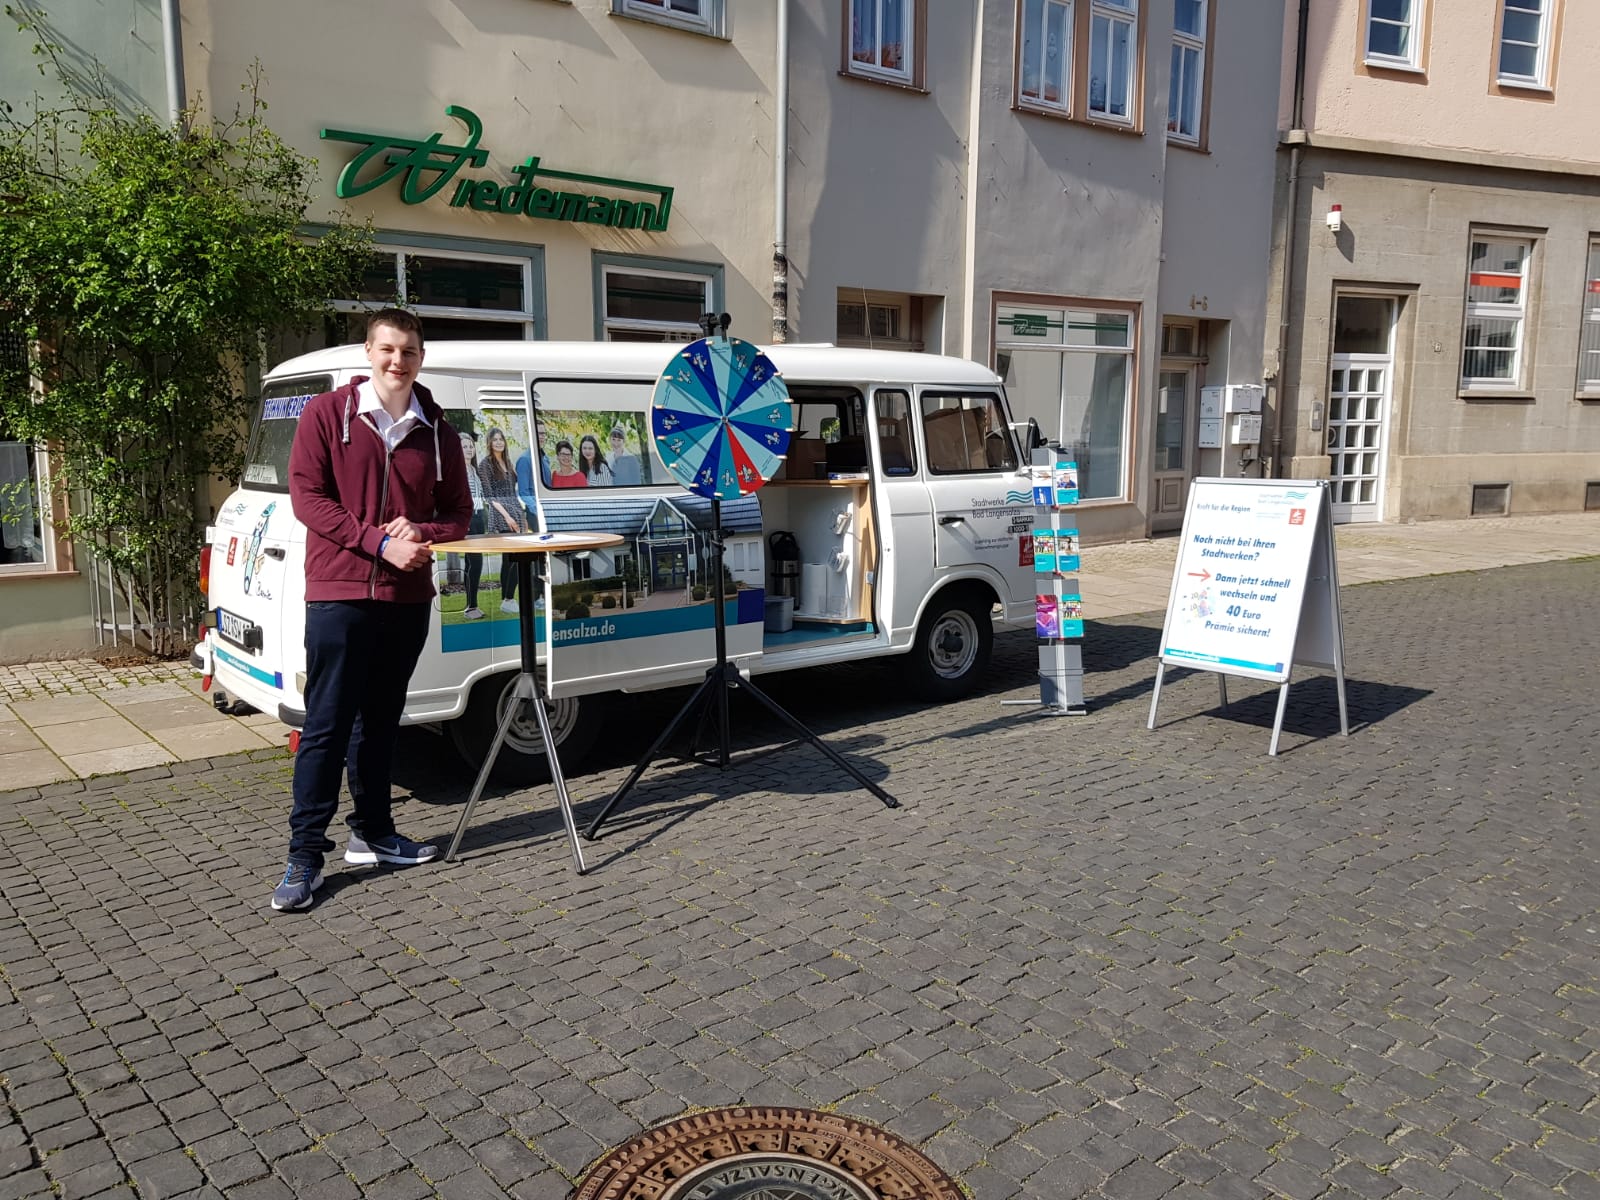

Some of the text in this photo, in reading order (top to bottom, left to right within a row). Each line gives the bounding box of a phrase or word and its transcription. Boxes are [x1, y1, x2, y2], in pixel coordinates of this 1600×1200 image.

[971, 497, 1005, 507] Stadtwerke
[972, 507, 1021, 520] Bad Langensalza
[1231, 505, 1251, 514] Region
[1193, 534, 1276, 549] Noch nicht bei Ihren
[1201, 548, 1260, 562] Stadtwerken?
[1215, 573, 1291, 589] Dann jetzt schnell
[1220, 588, 1277, 603] wechseln und
[1226, 604, 1262, 620] 40 Euro
[552, 620, 615, 641] ensalza.de
[1238, 624, 1271, 638] sichern!
